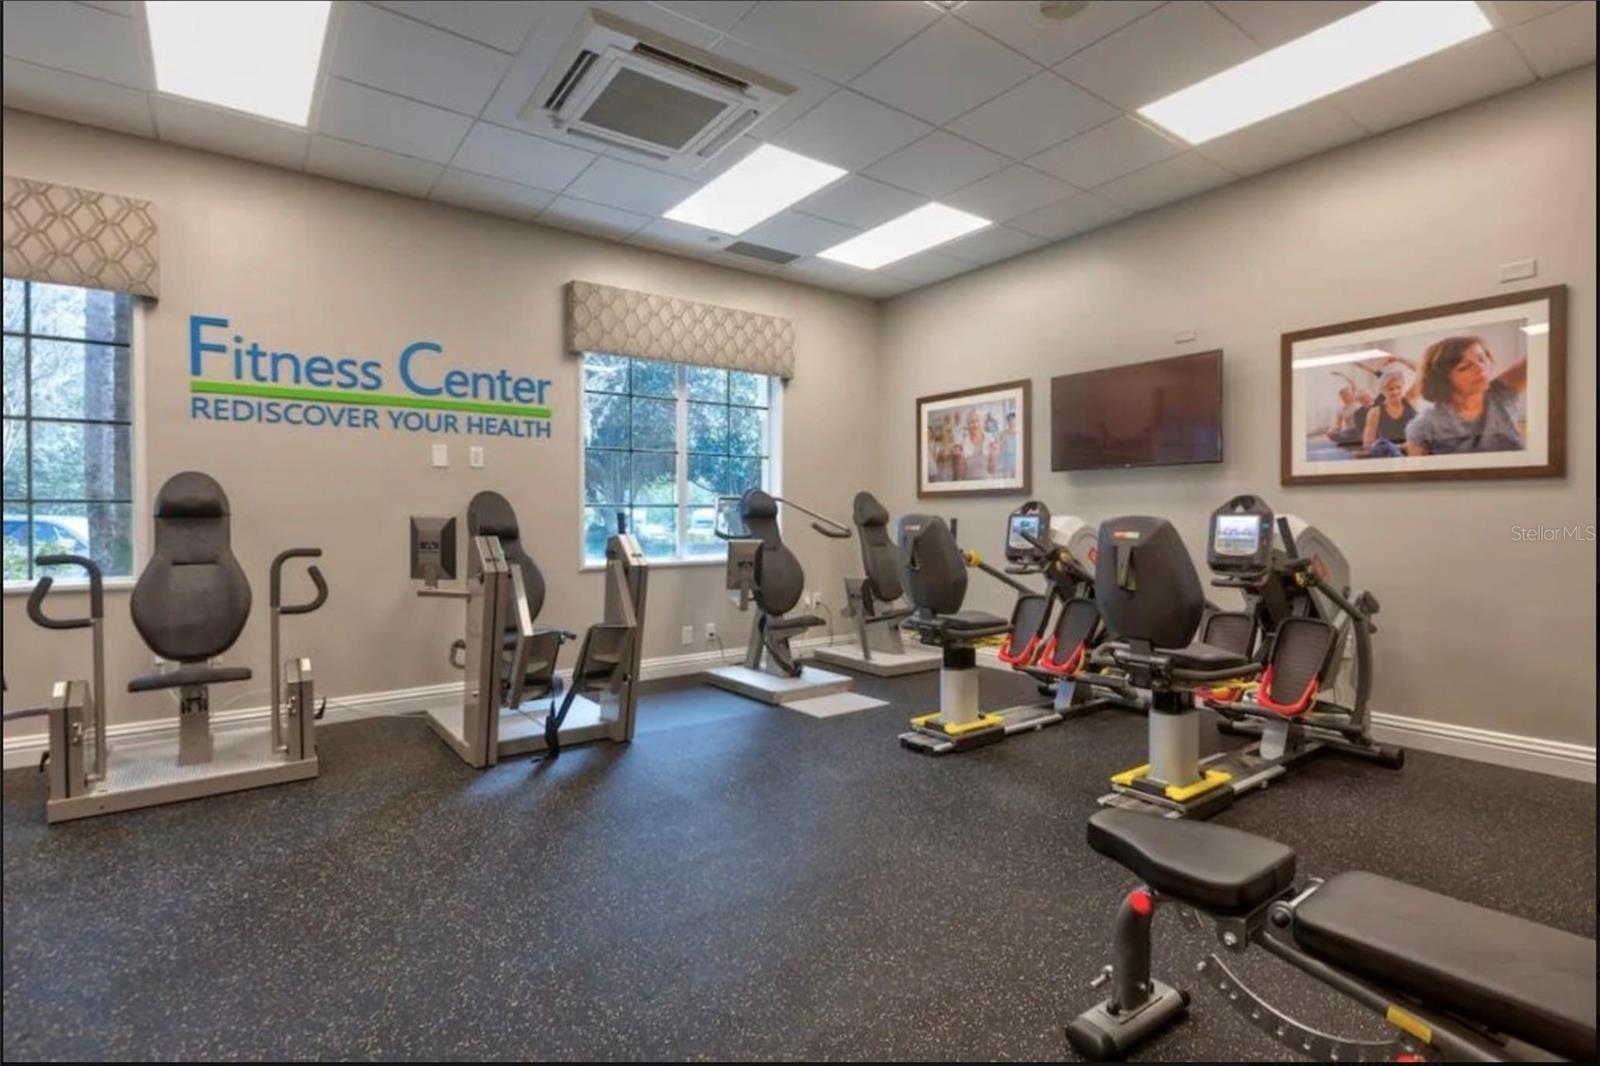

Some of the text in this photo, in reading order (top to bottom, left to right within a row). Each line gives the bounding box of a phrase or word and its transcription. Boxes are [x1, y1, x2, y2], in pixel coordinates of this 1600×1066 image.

[190, 314, 551, 405] Fitness Center
[191, 397, 552, 439] REDISCOVER YOUR HEALTH
